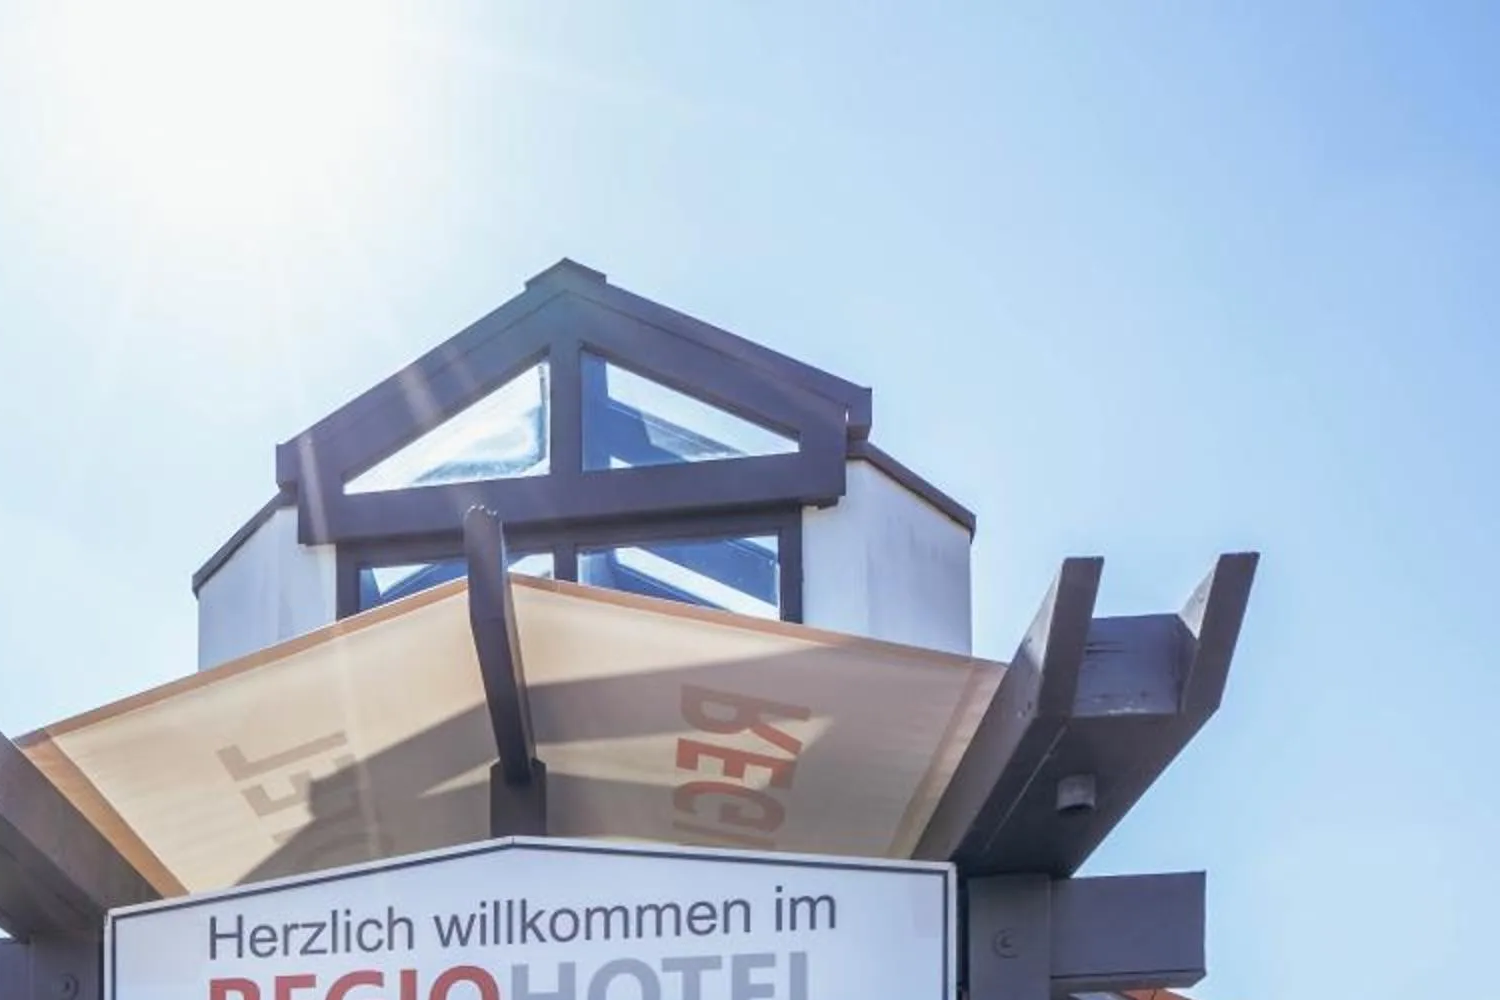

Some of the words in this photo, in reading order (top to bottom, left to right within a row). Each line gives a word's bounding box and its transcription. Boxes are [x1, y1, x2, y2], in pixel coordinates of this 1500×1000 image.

[209, 905, 416, 961] Herzlich
[432, 897, 752, 949] willkommen
[773, 884, 837, 934] im
